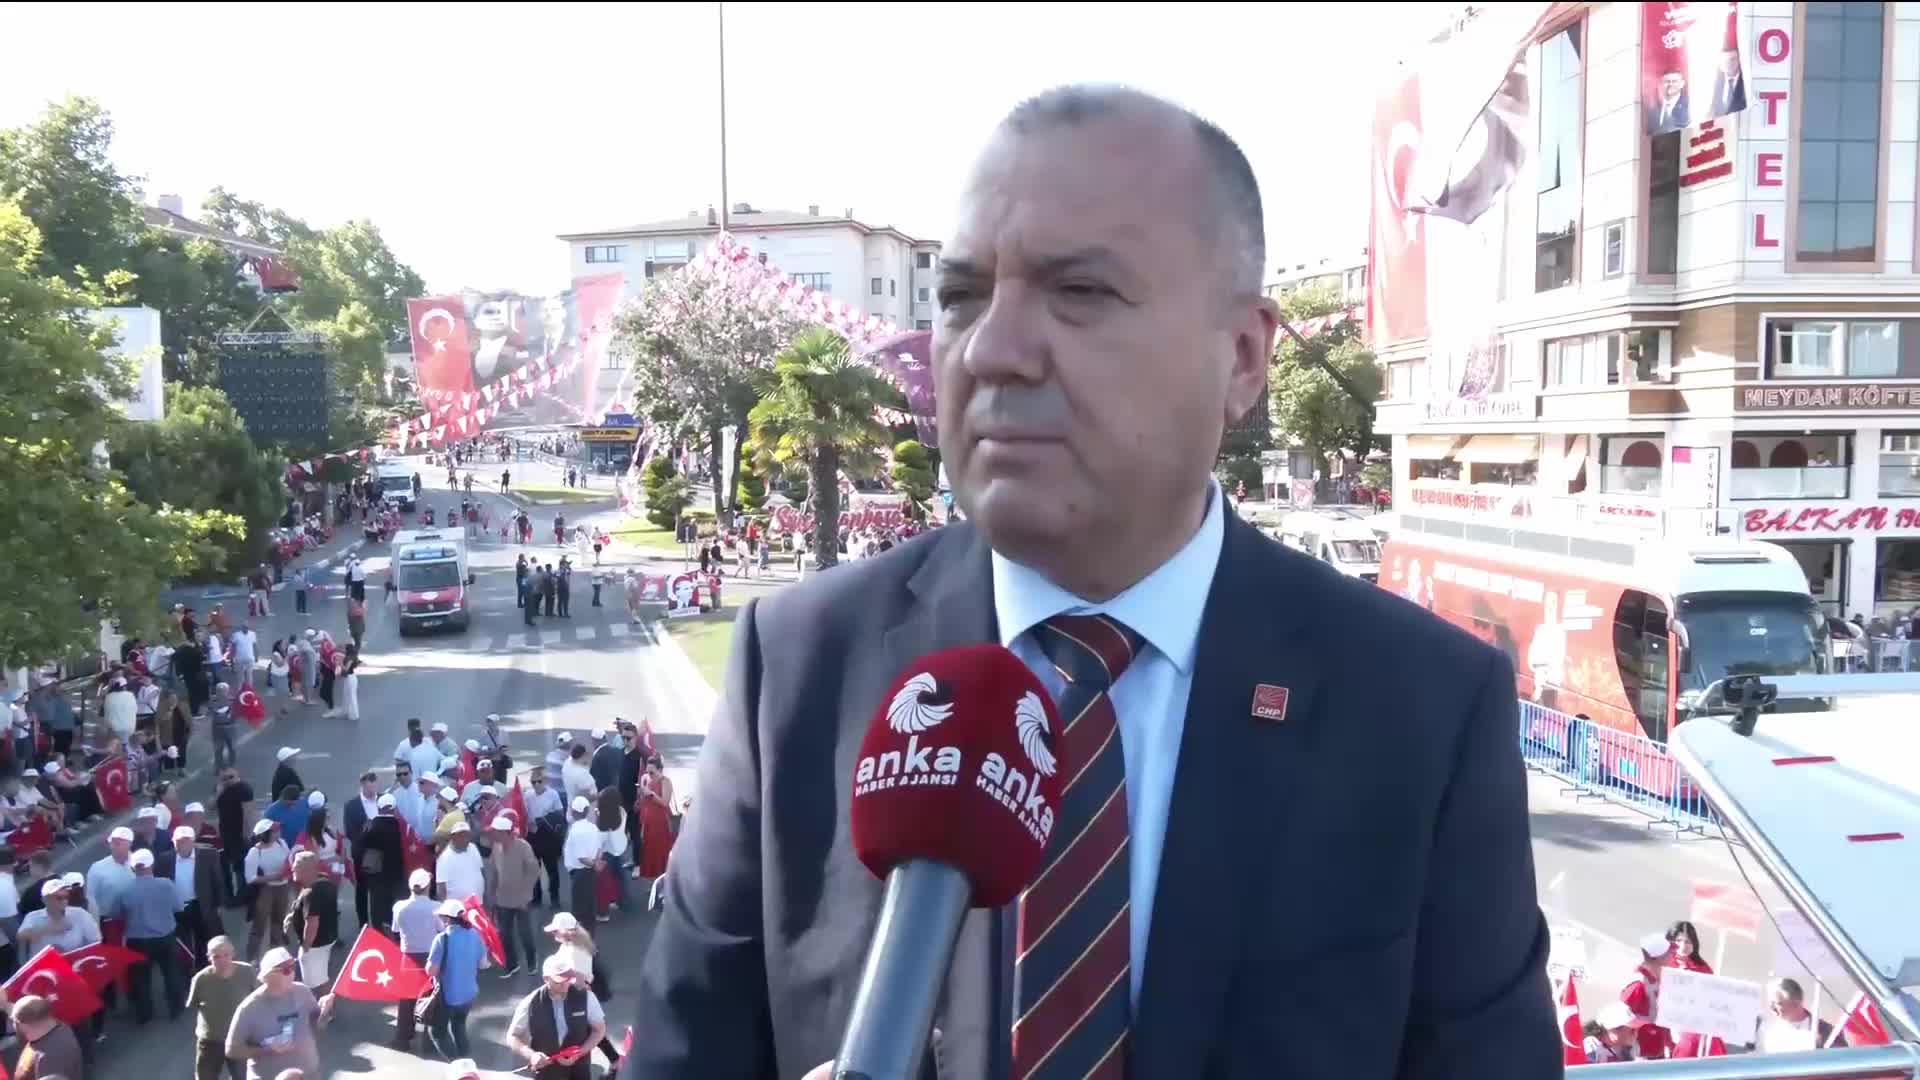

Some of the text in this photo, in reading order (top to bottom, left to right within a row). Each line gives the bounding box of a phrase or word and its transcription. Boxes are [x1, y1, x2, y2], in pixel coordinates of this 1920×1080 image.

[1755, 28, 1790, 249] OTEL
[1744, 388, 1841, 407] MEYDAN
[1744, 507, 1888, 533] BALKAN
[1257, 706, 1281, 716] CHP
[856, 735, 962, 783] anka
[855, 773, 957, 797] HABER AJANSI
[981, 752, 1054, 838] anka
[976, 775, 1047, 849] HABER AJANSI
